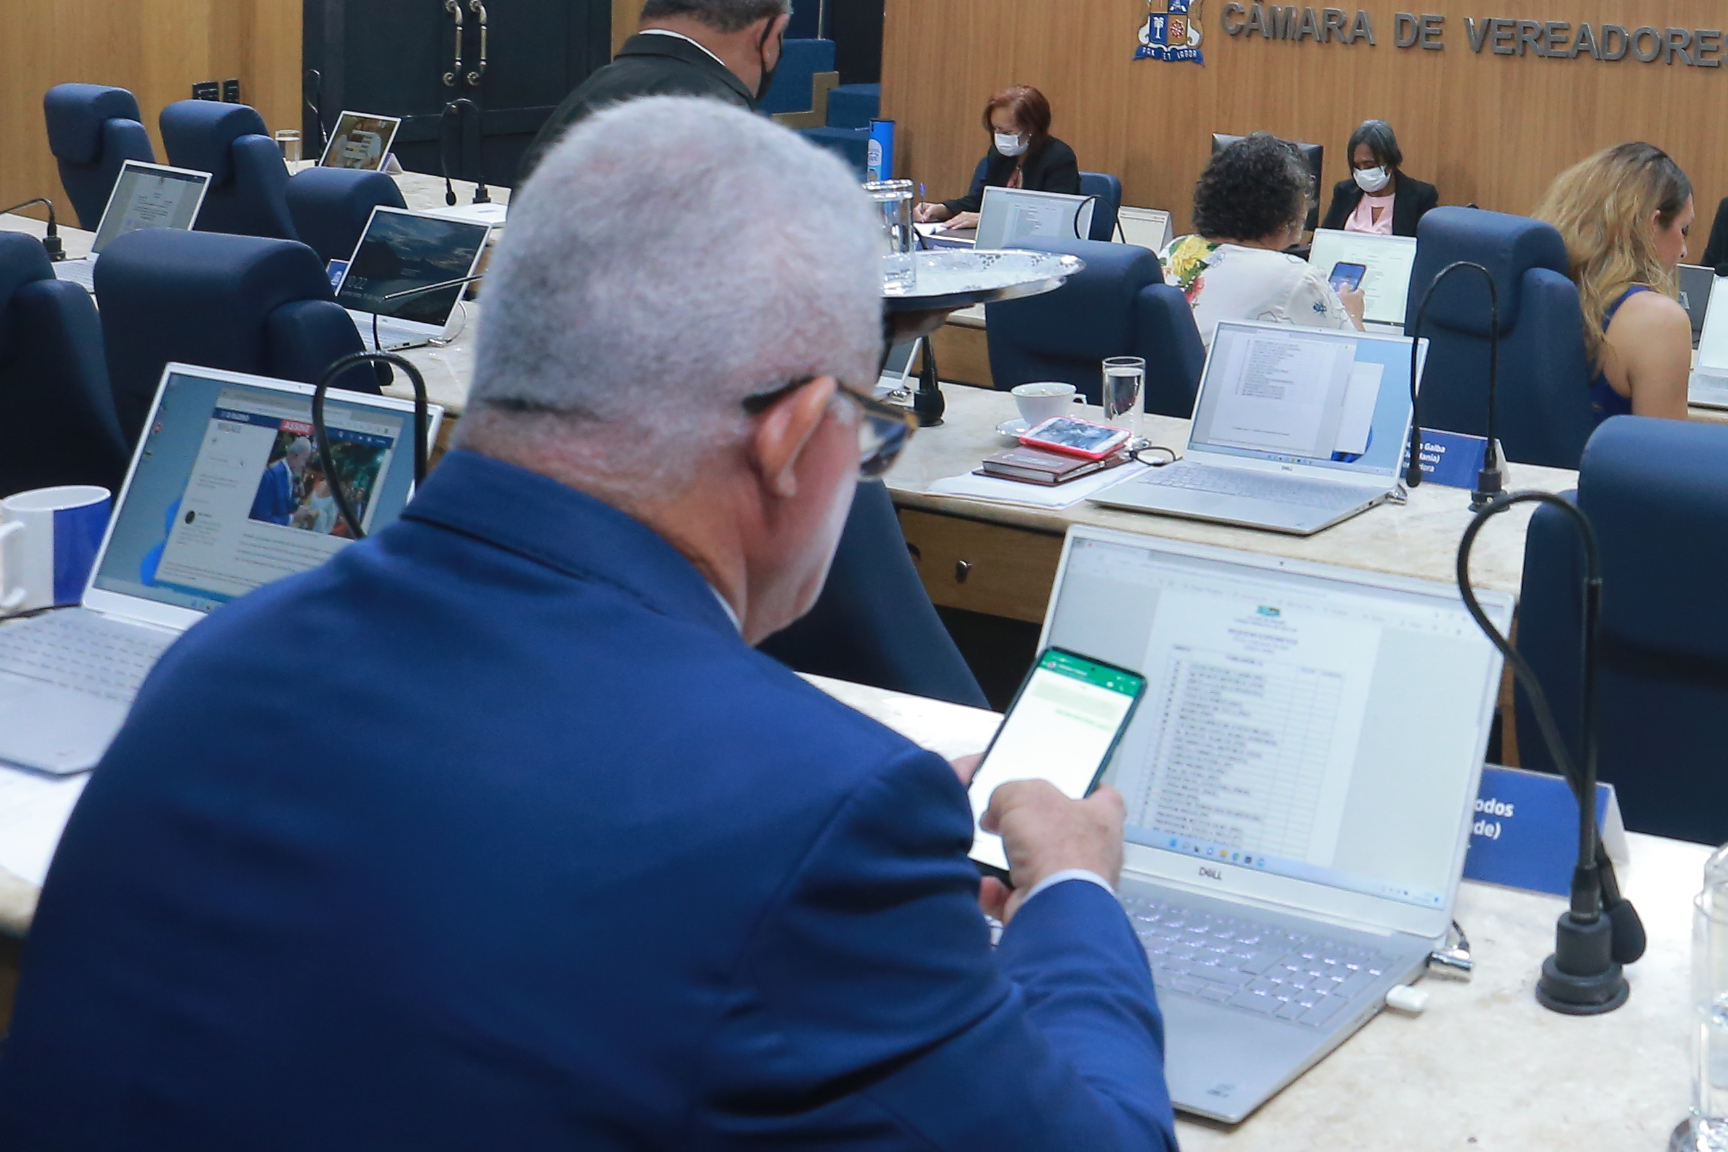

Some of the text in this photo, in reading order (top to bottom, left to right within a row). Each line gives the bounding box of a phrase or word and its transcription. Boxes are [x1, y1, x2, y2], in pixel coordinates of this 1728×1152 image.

[1394, 12, 1445, 50] DE
[1424, 442, 1446, 453] Galba
[1474, 798, 1514, 817] odos
